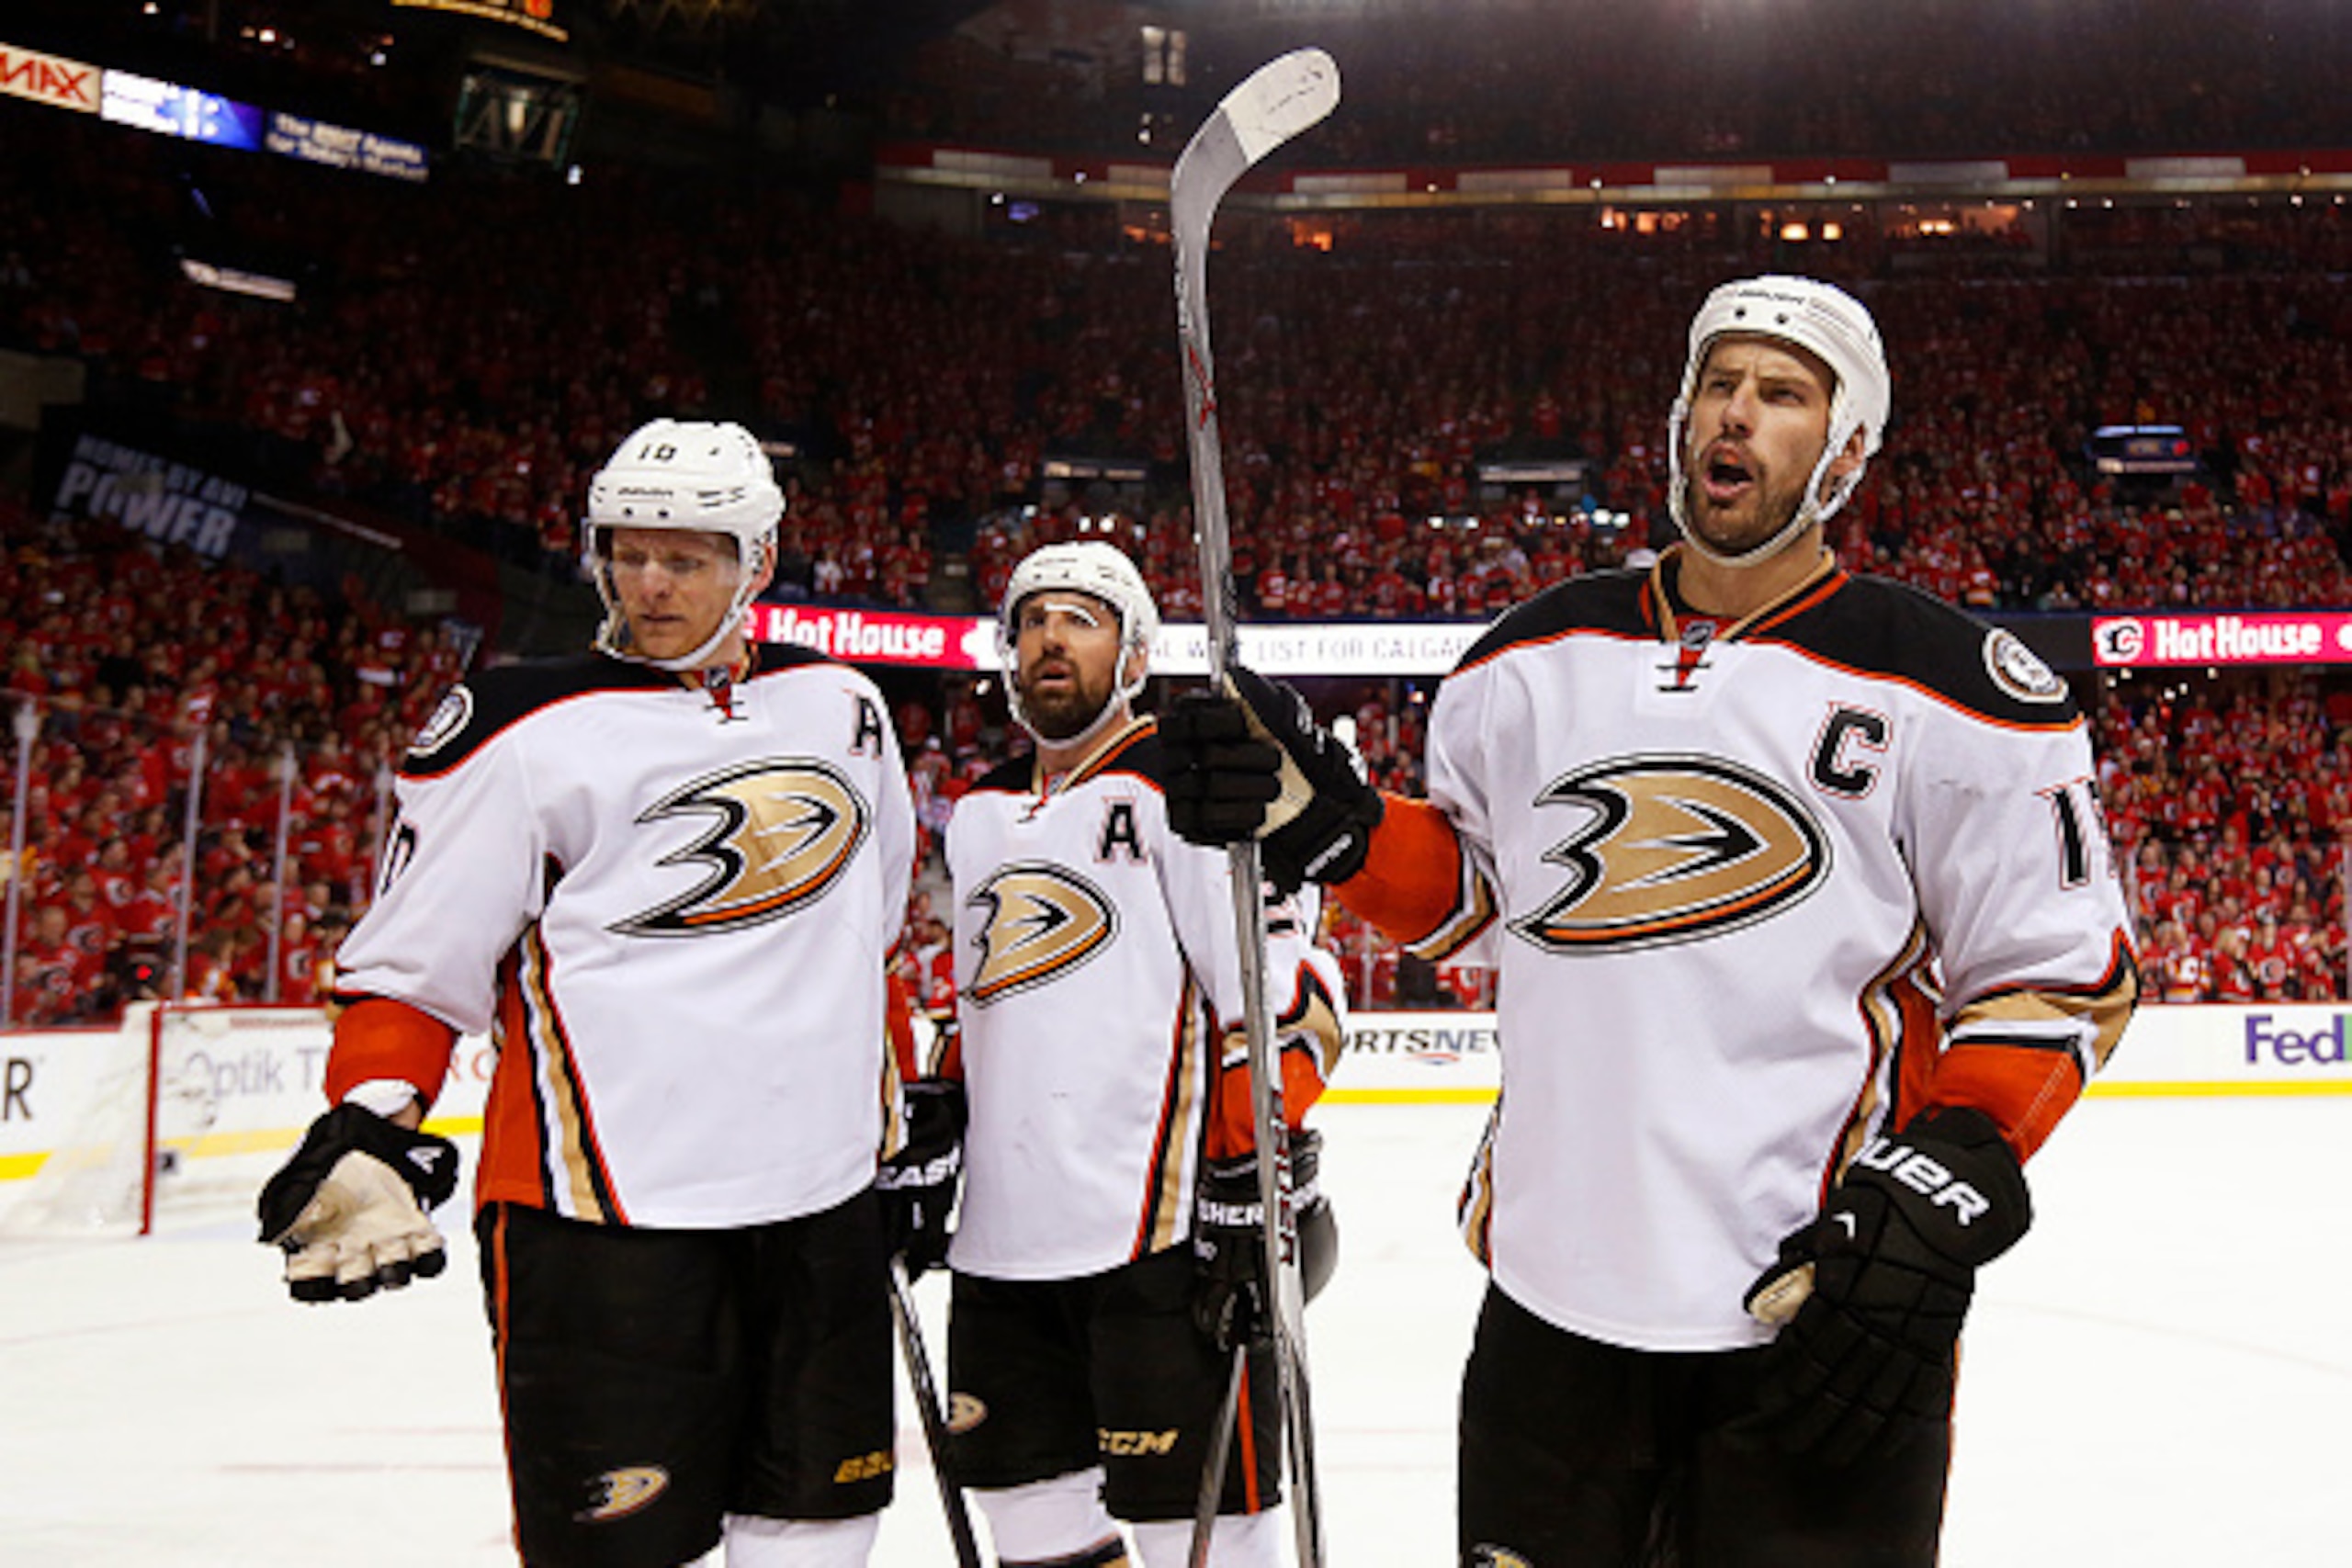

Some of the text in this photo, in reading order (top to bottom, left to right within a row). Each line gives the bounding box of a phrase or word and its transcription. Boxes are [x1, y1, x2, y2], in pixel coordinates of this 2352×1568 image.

[54, 461, 237, 558] POWER
[2214, 615, 2322, 658] House
[849, 691, 884, 757] A
[1806, 701, 1893, 799] C
[1096, 798, 1146, 863] A
[1342, 1028, 1501, 1055] RTSNE
[1850, 1135, 1991, 1227] UER
